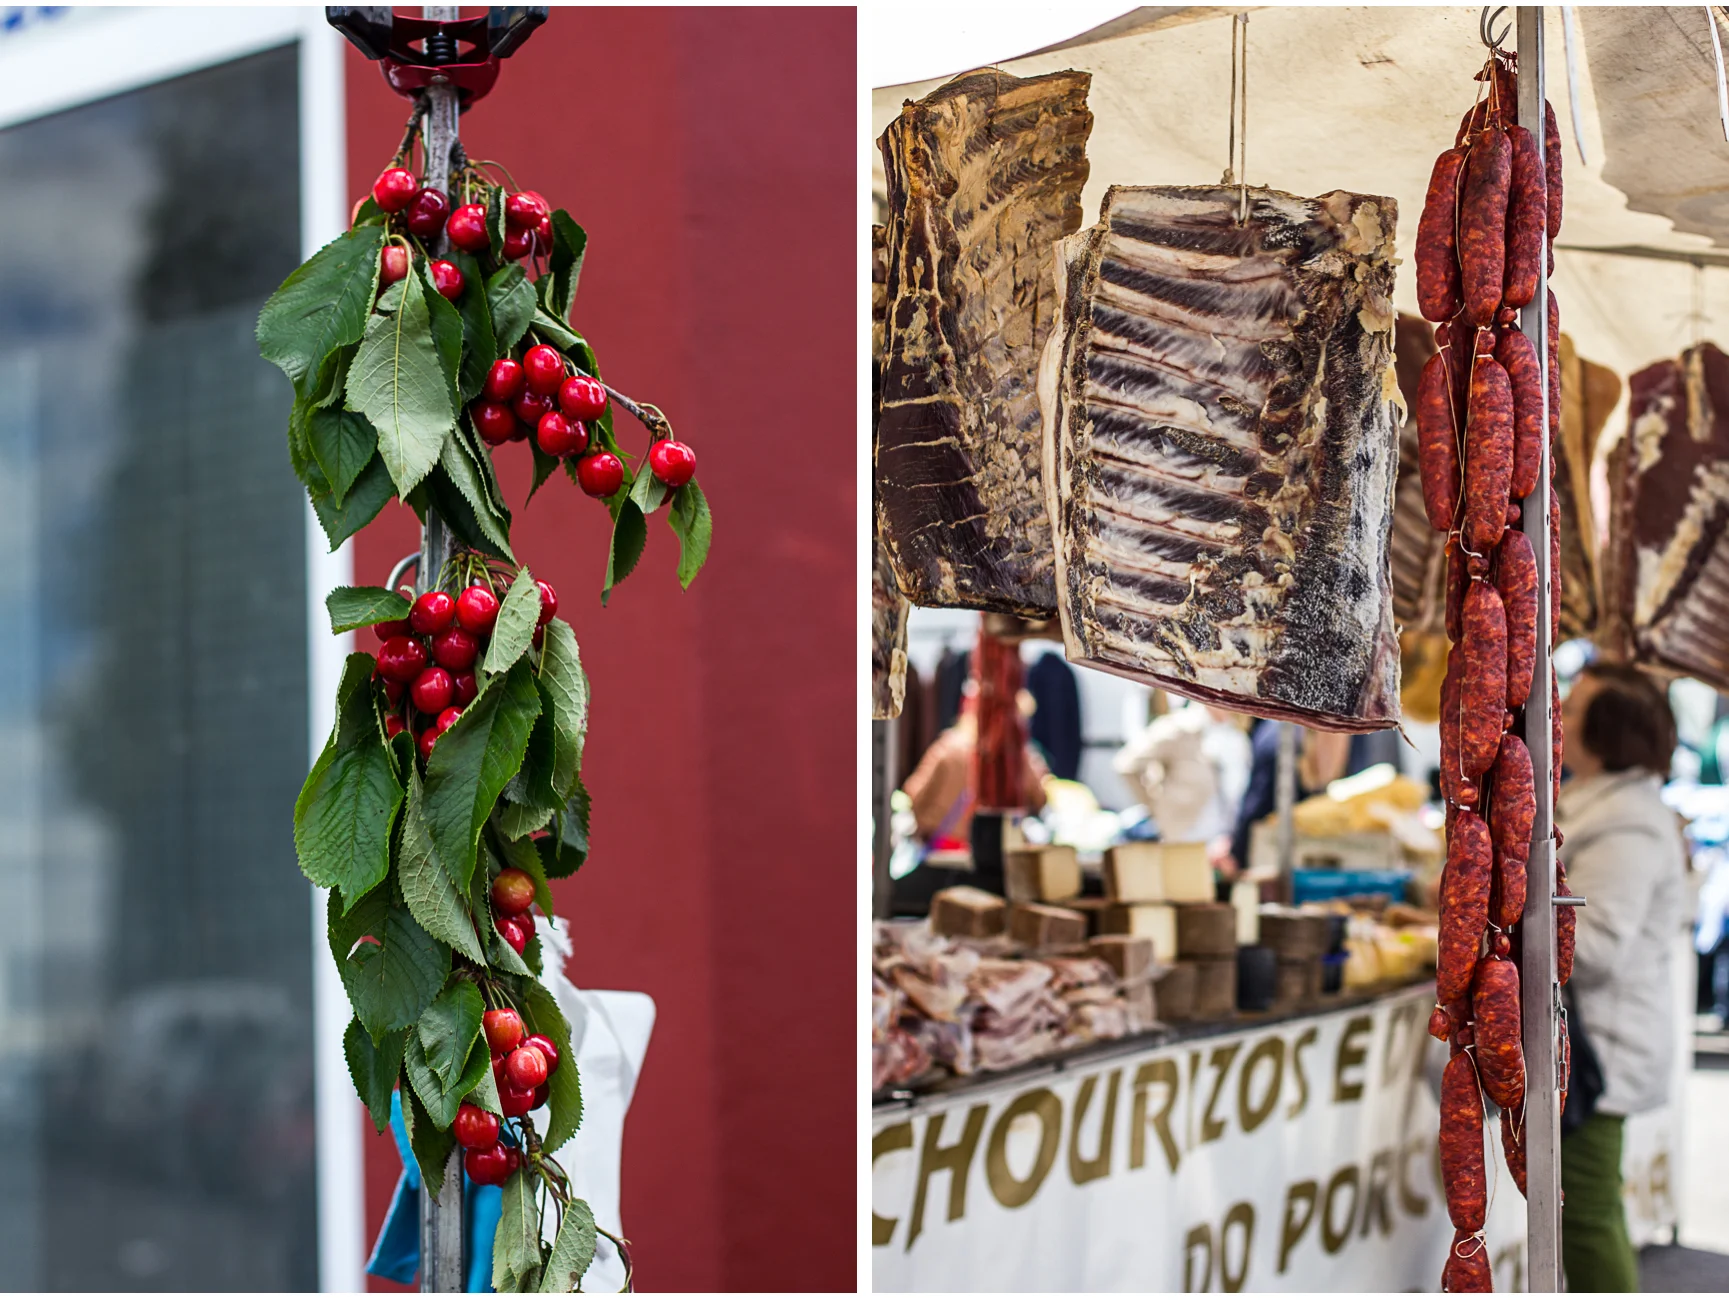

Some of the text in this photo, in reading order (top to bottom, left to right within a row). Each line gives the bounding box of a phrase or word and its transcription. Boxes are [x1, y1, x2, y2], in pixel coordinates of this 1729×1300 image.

[872, 1025, 1318, 1254] CHOURIZOS
[1333, 1014, 1374, 1104] E
[1184, 1197, 1255, 1292] DO
